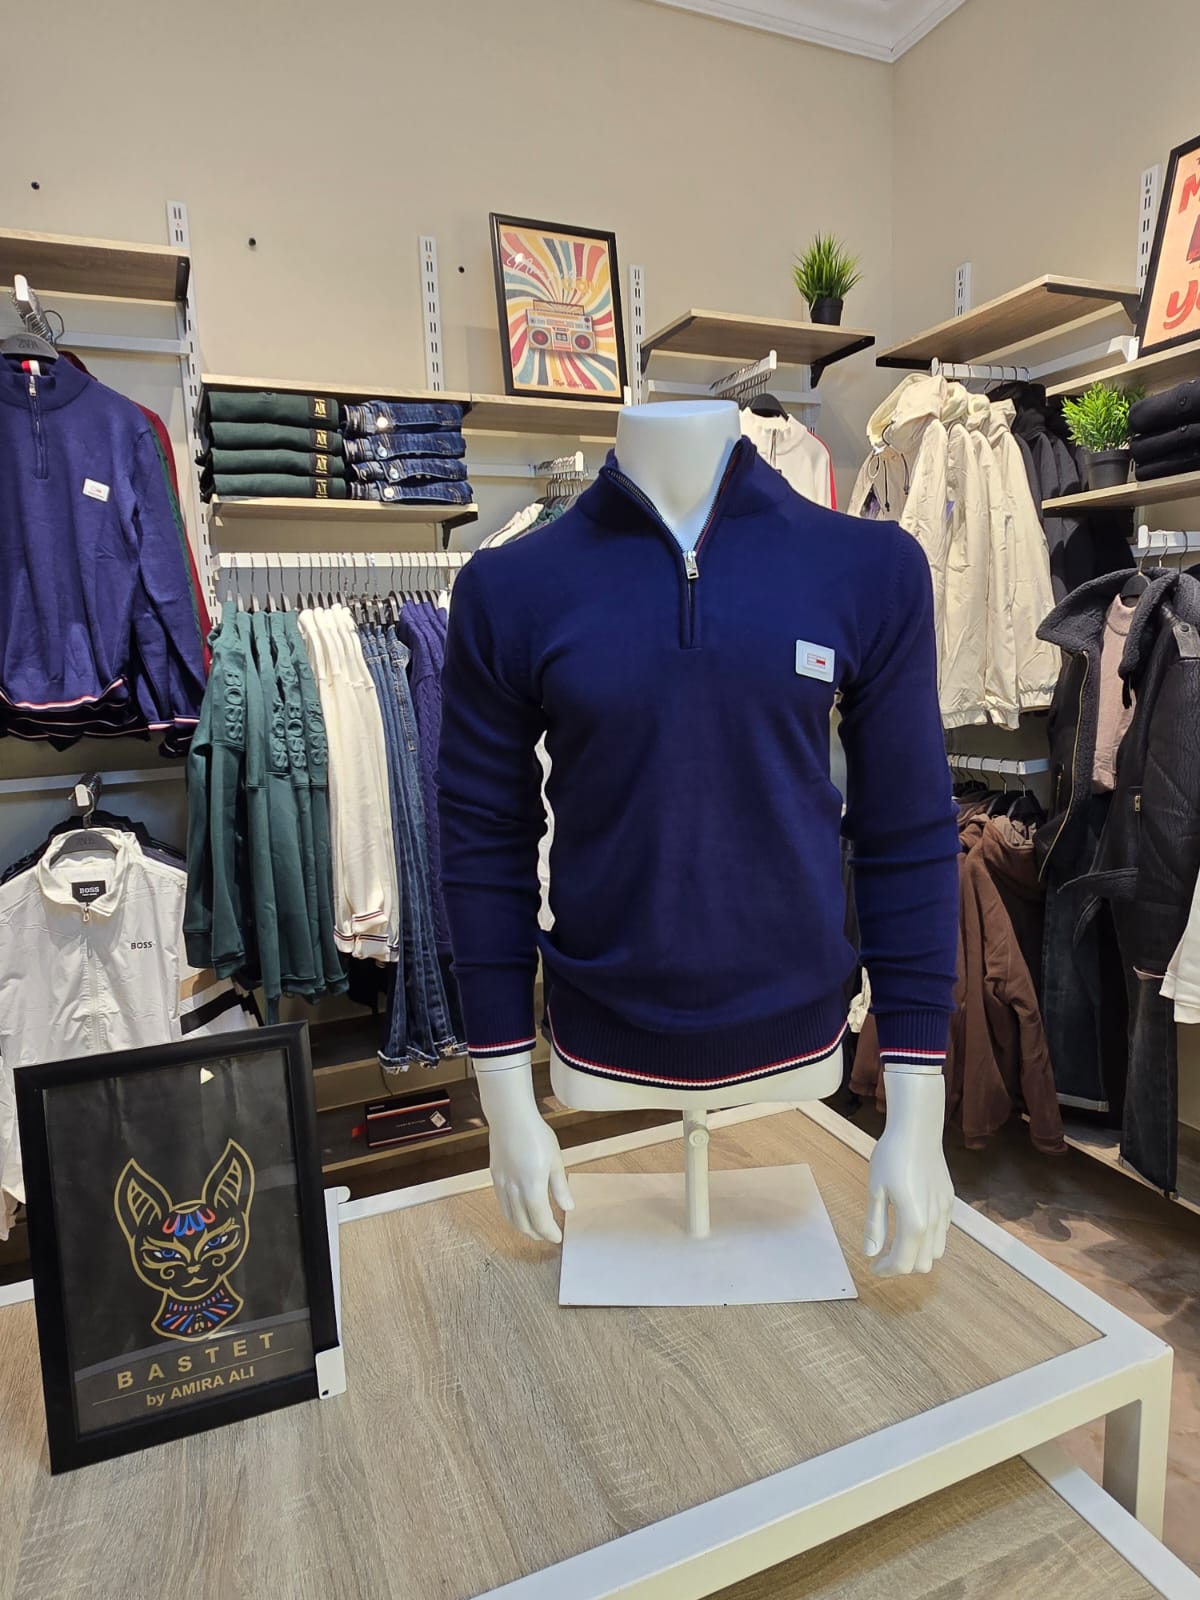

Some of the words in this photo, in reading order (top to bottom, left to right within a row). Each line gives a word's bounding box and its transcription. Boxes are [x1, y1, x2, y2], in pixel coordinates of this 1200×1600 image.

[224, 671, 244, 741] BOSS
[287, 705, 307, 768] BOSS
[130, 941, 153, 950] BOSS
[117, 1332, 274, 1390] BASTET
[146, 1392, 166, 1407] by
[170, 1375, 224, 1400] AMIRA
[228, 1365, 255, 1384] ALI
